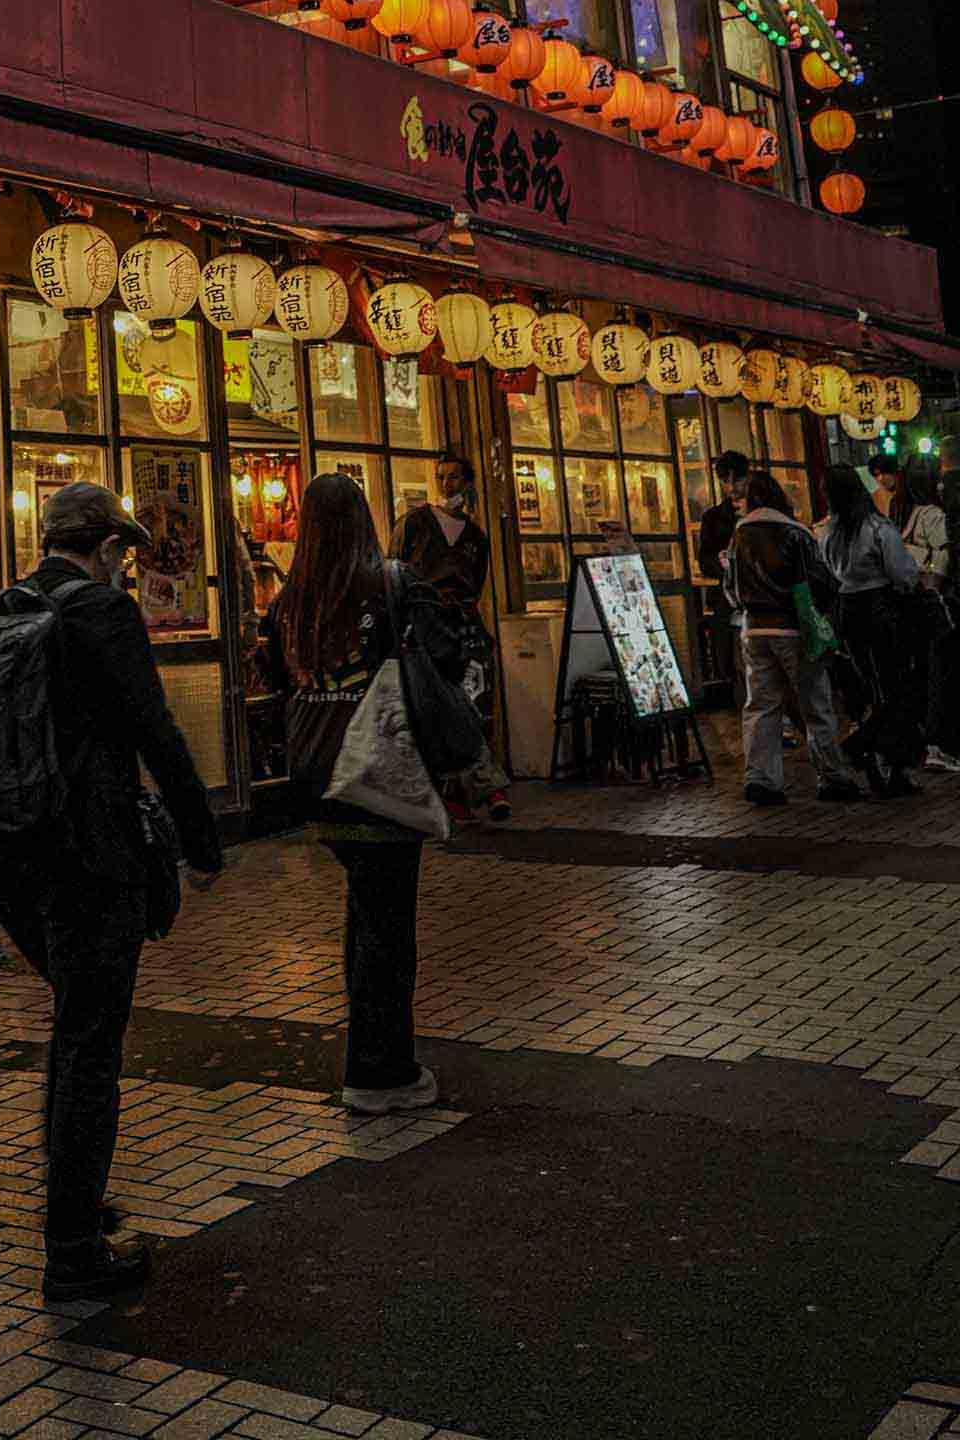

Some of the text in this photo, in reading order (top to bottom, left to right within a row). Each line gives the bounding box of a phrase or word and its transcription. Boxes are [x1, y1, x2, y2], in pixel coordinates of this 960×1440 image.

[35, 236, 66, 298] 新宿苑
[121, 250, 152, 312] 新宿苑
[204, 264, 235, 322] 新宿苑
[279, 275, 310, 332] 新宿苑
[602, 330, 626, 372] 貝道
[659, 343, 681, 384] 貝道
